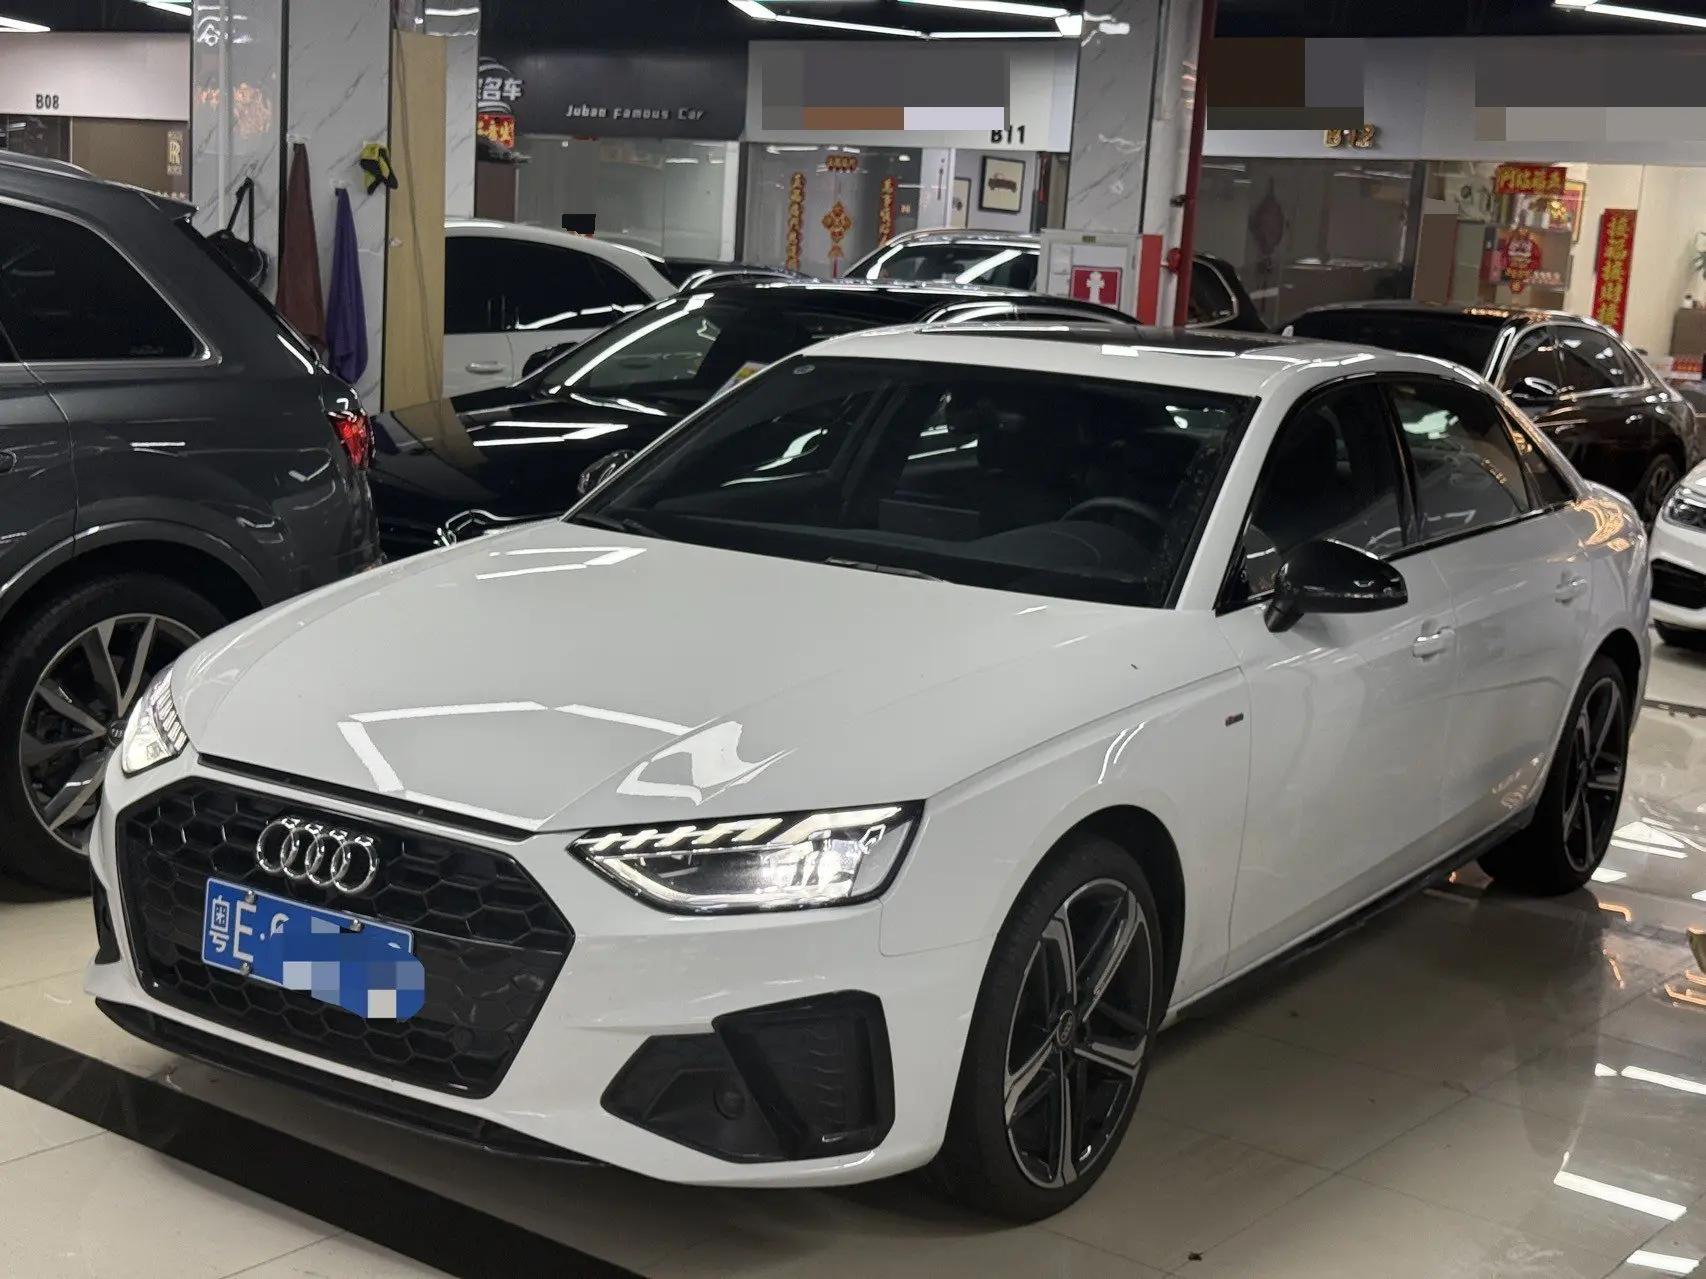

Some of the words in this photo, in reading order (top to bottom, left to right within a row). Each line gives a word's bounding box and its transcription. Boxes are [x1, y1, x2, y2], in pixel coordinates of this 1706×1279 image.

[35, 94, 60, 110] B08
[678, 106, 705, 121] Car
[990, 124, 1026, 145] B11
